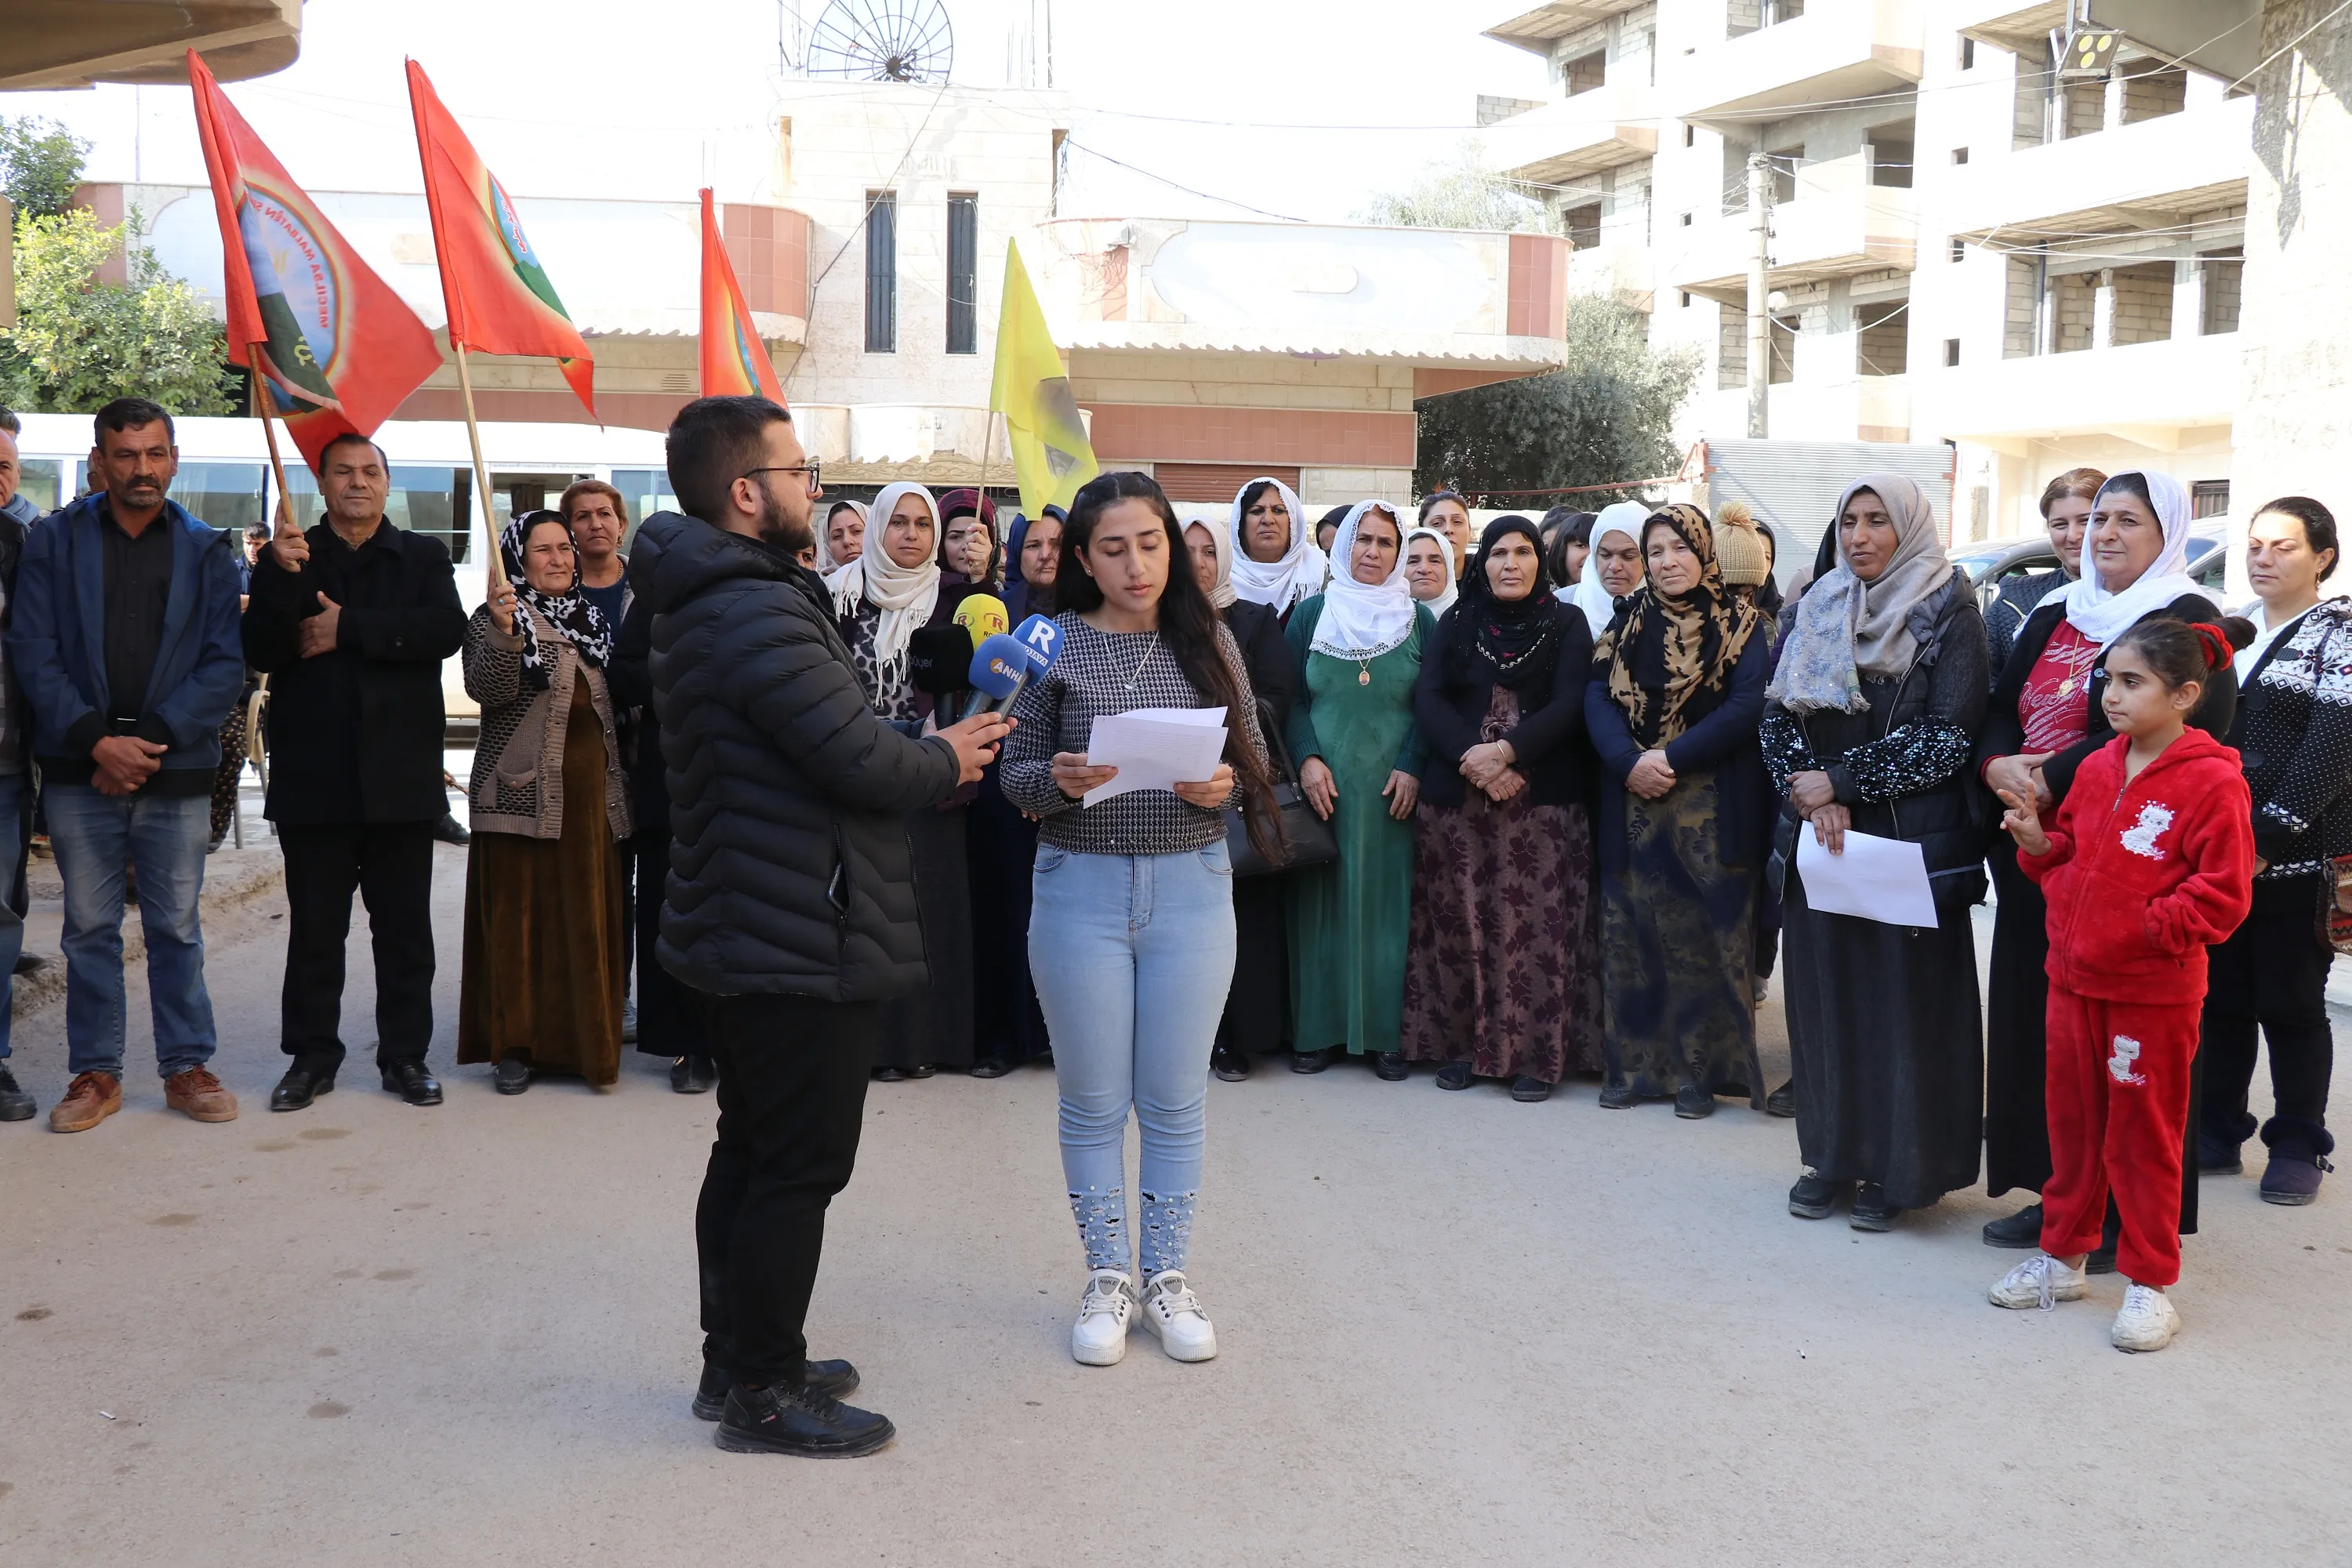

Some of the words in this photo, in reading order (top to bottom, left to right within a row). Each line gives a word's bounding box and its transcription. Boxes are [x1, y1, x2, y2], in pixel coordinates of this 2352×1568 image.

[993, 617, 1003, 631] R
[1027, 619, 1055, 655] R
[1023, 645, 1047, 666] OJAVA
